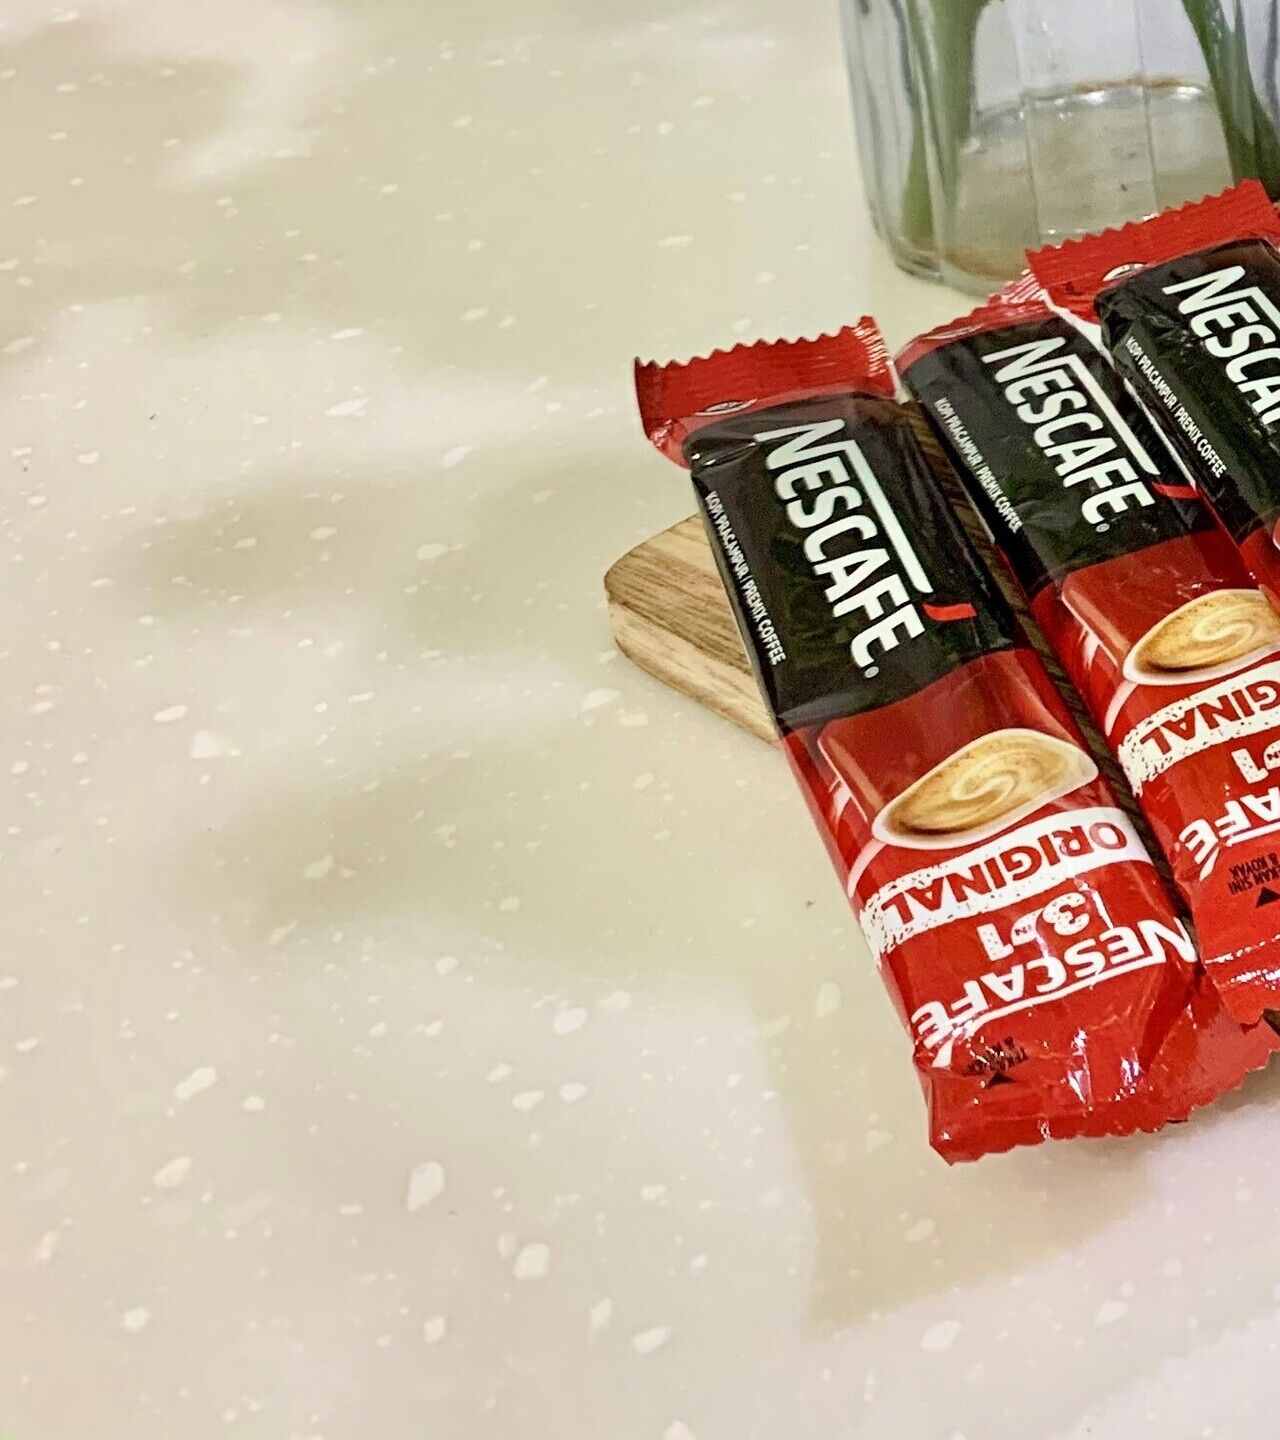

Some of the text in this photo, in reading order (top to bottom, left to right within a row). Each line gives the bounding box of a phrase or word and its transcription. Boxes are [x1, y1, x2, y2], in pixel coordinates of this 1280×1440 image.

[1125, 336, 1144, 362] KOPI
[1138, 354, 1179, 410] PRACAMPUR
[1173, 406, 1203, 444] PREMIX
[1196, 438, 1227, 479] COFFEE
[705, 490, 725, 520] KOPI
[742, 579, 768, 623] PREMIX
[757, 618, 787, 666] COFFEE
[1230, 748, 1269, 784] 1
[880, 822, 1129, 927] ORIGINAL
[976, 923, 1015, 962] 1
[1041, 891, 1091, 936] 3
